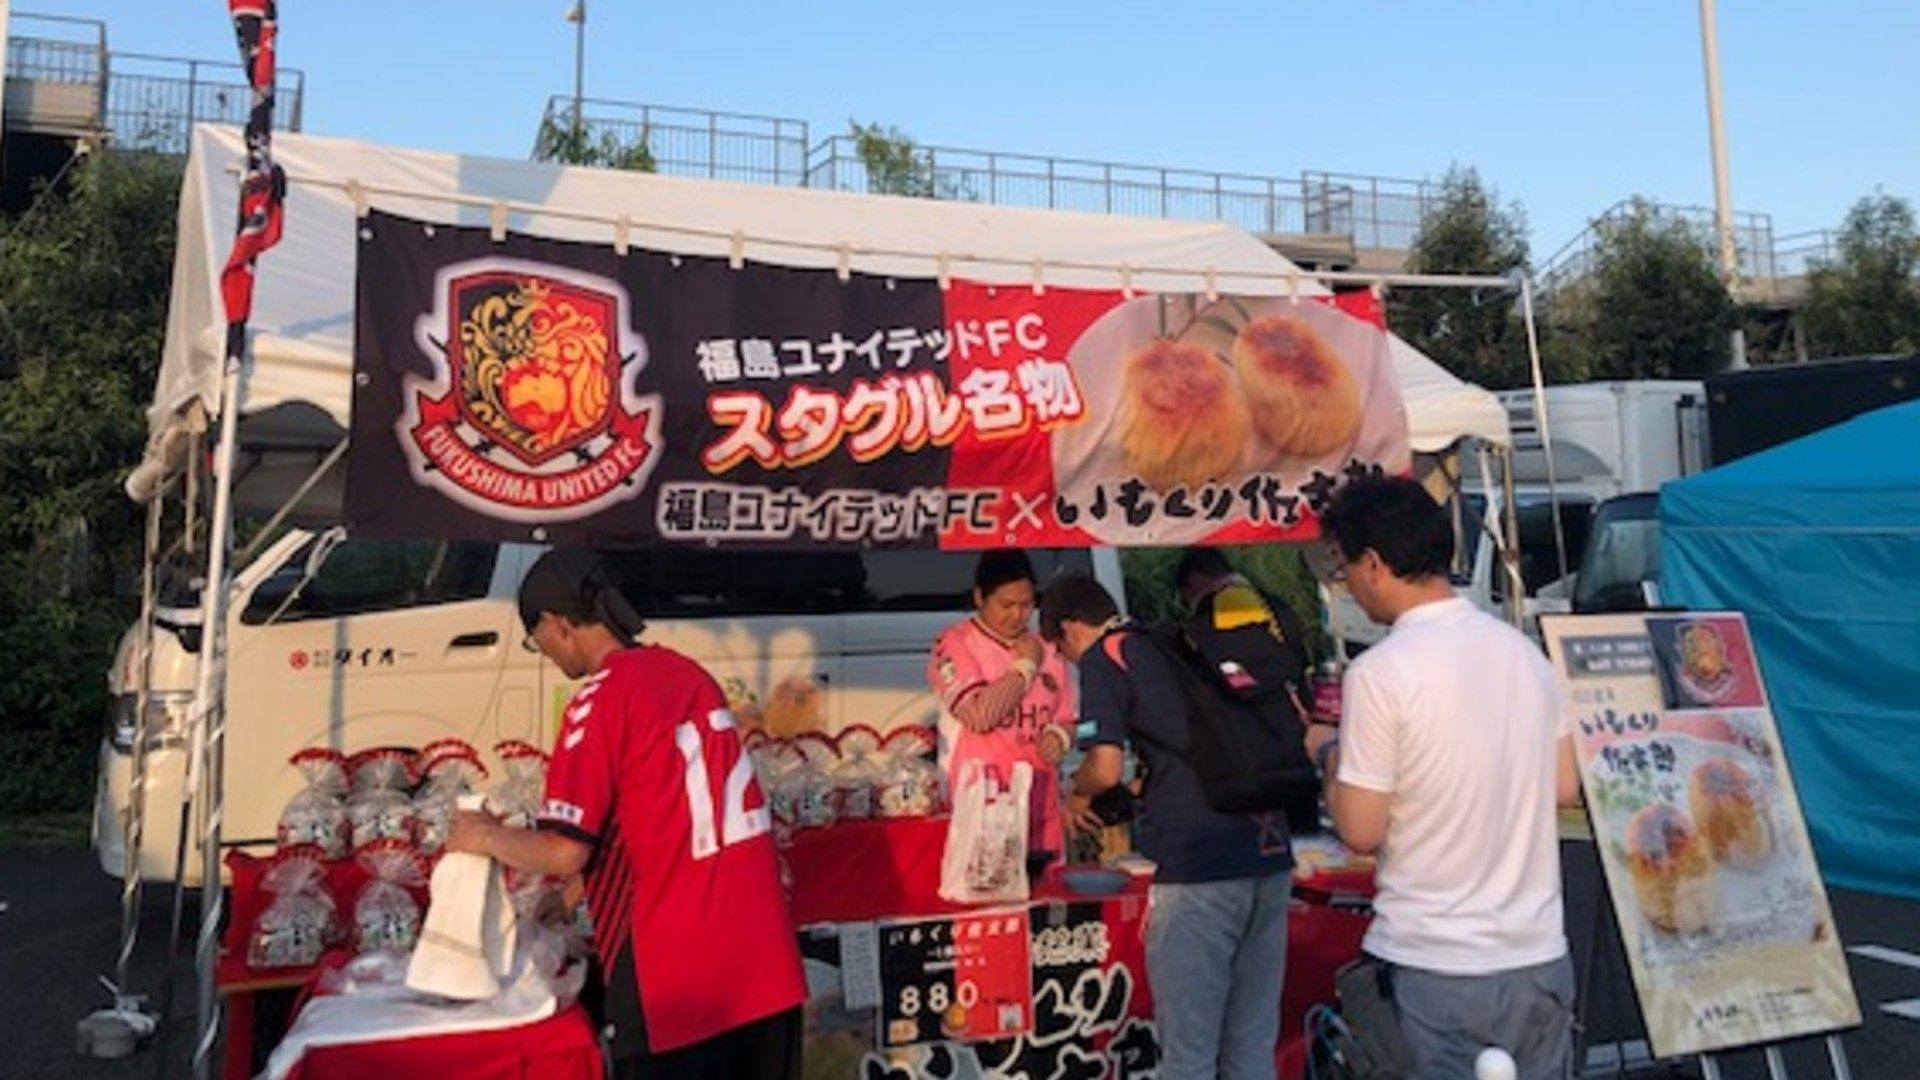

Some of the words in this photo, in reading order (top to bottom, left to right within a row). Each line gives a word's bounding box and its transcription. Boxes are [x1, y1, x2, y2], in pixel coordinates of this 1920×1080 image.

[697, 313, 1048, 381] 福島ユナイテッドFC
[705, 358, 1085, 474] スタグル名物
[421, 424, 538, 502] FUKUSHIMA
[542, 462, 619, 503] UNITED
[614, 438, 643, 470] FC
[675, 708, 773, 861] 12
[900, 979, 979, 1017] 880
